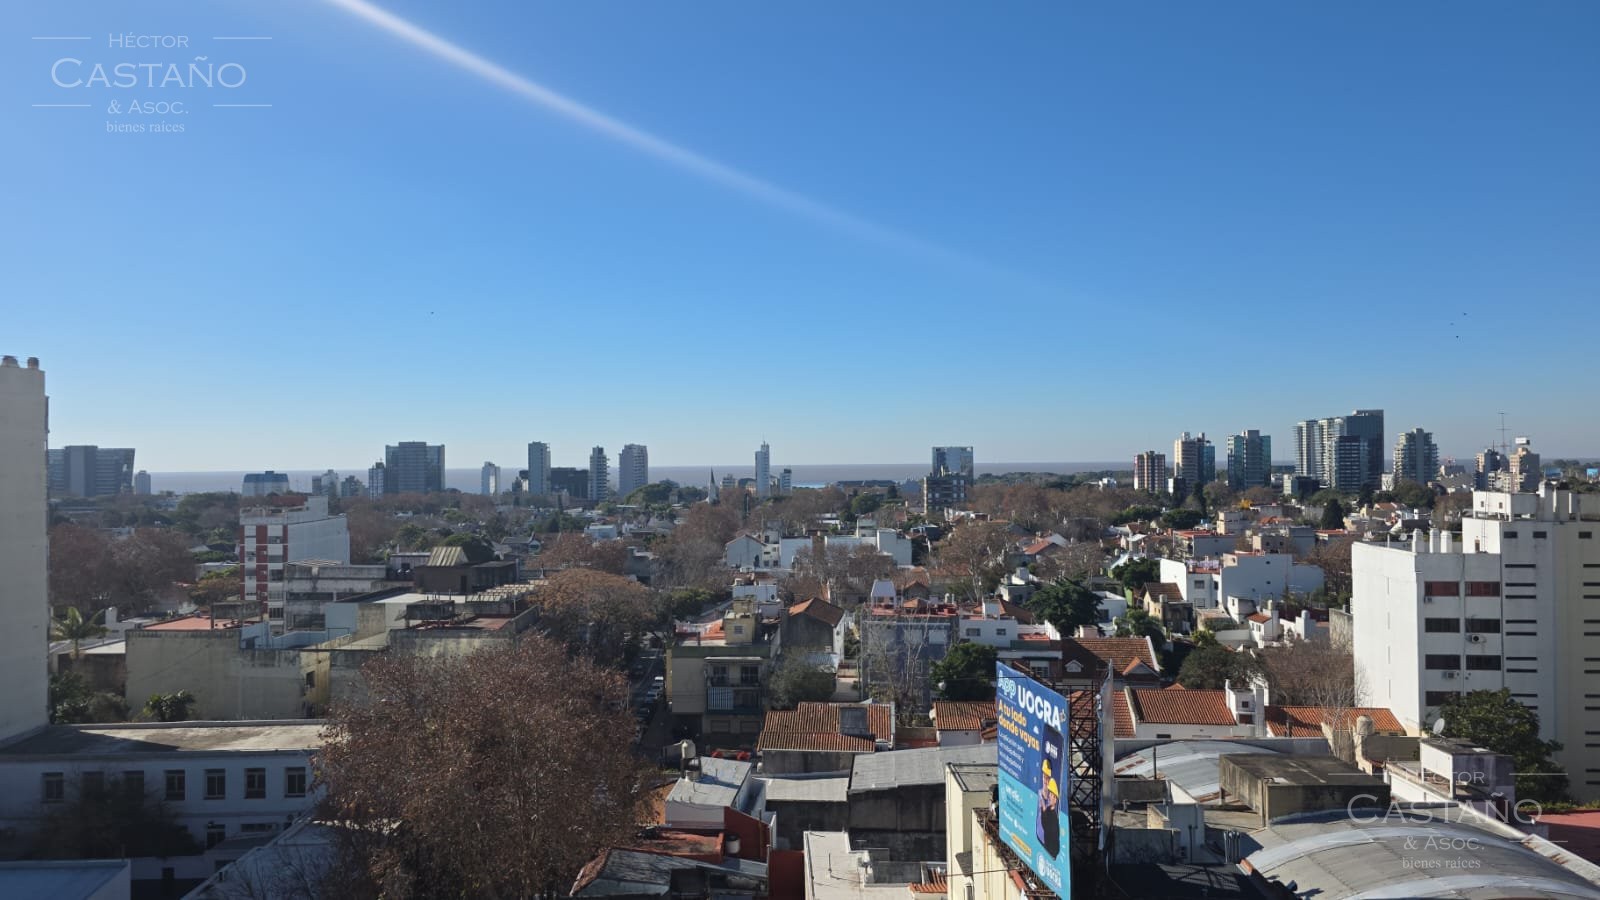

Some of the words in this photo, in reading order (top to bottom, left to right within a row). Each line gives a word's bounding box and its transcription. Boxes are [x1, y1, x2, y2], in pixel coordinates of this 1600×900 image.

[1011, 706, 1027, 727] lado
[1017, 684, 1062, 732] UOCRA
[998, 713, 1019, 737] donde
[1019, 728, 1040, 753] vayas
